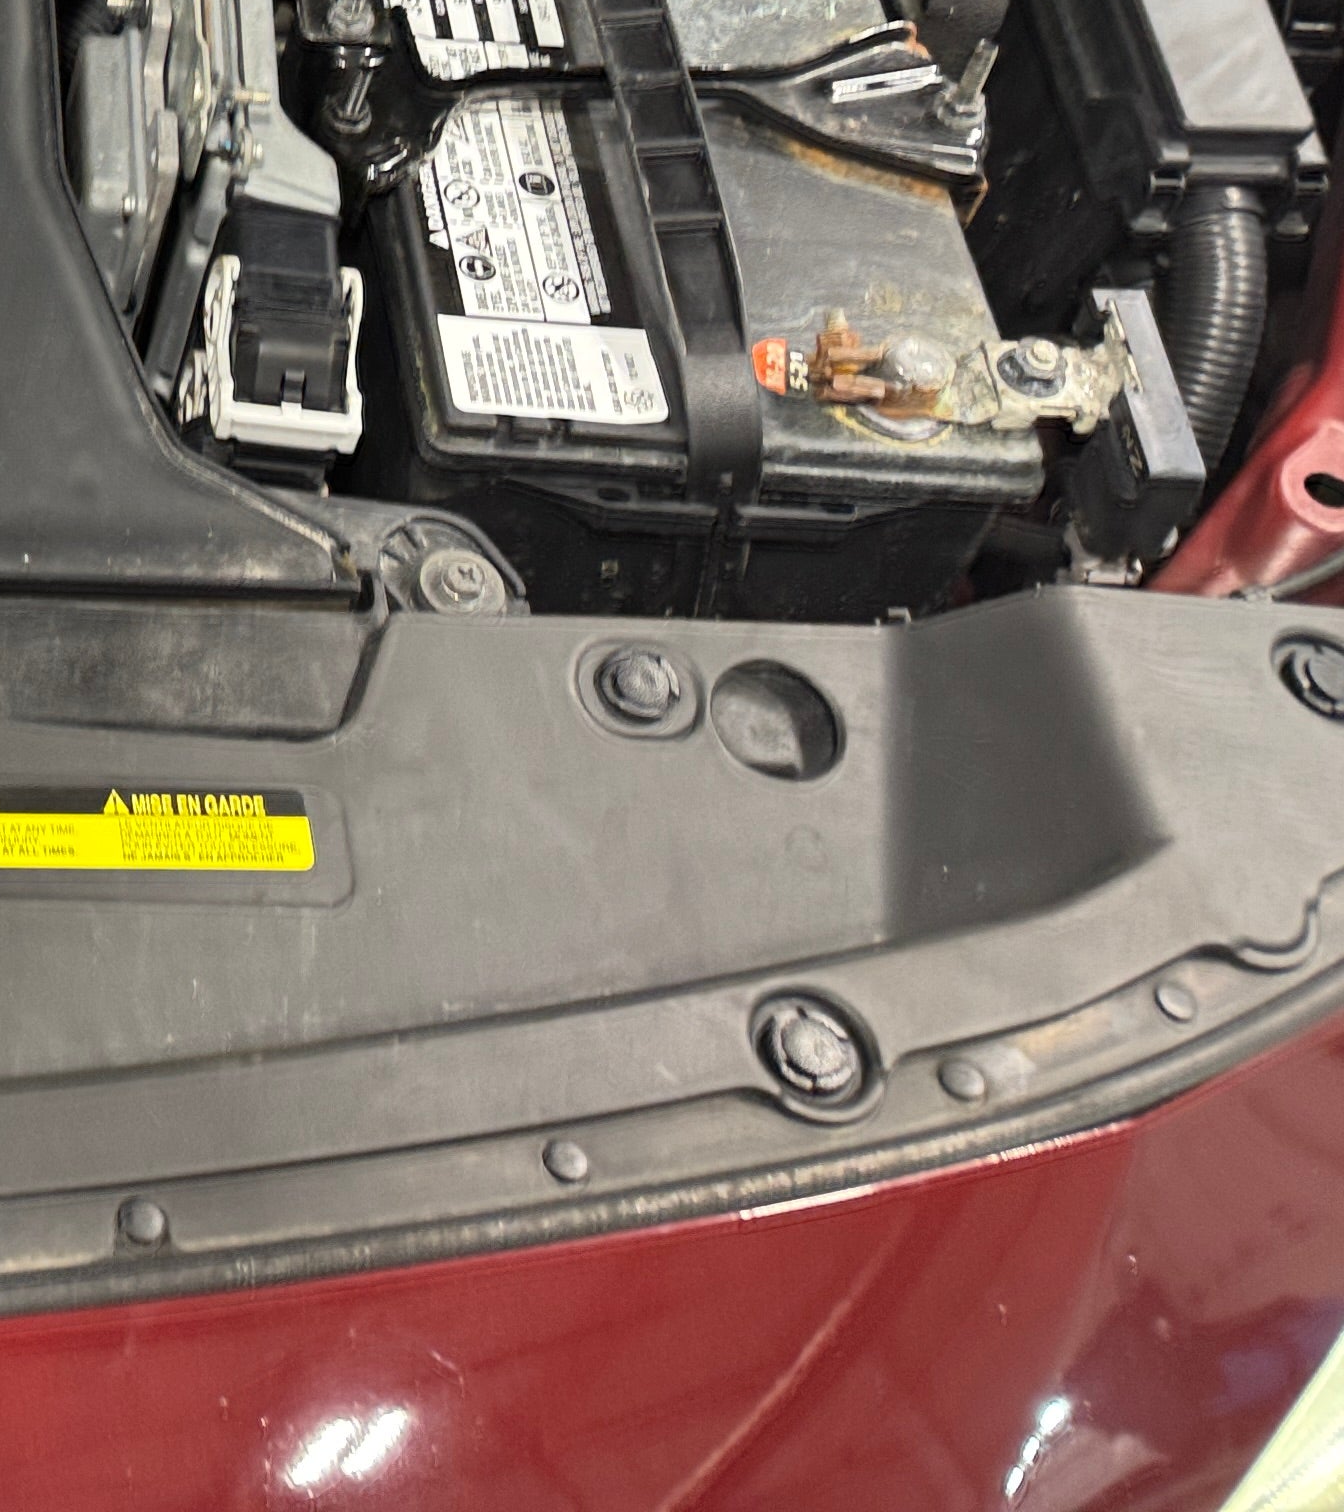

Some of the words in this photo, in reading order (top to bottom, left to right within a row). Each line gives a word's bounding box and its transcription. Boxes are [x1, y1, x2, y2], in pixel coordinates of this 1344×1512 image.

[131, 793, 174, 816] MISE
[176, 794, 201, 816] EN
[203, 794, 267, 817] GARDE
